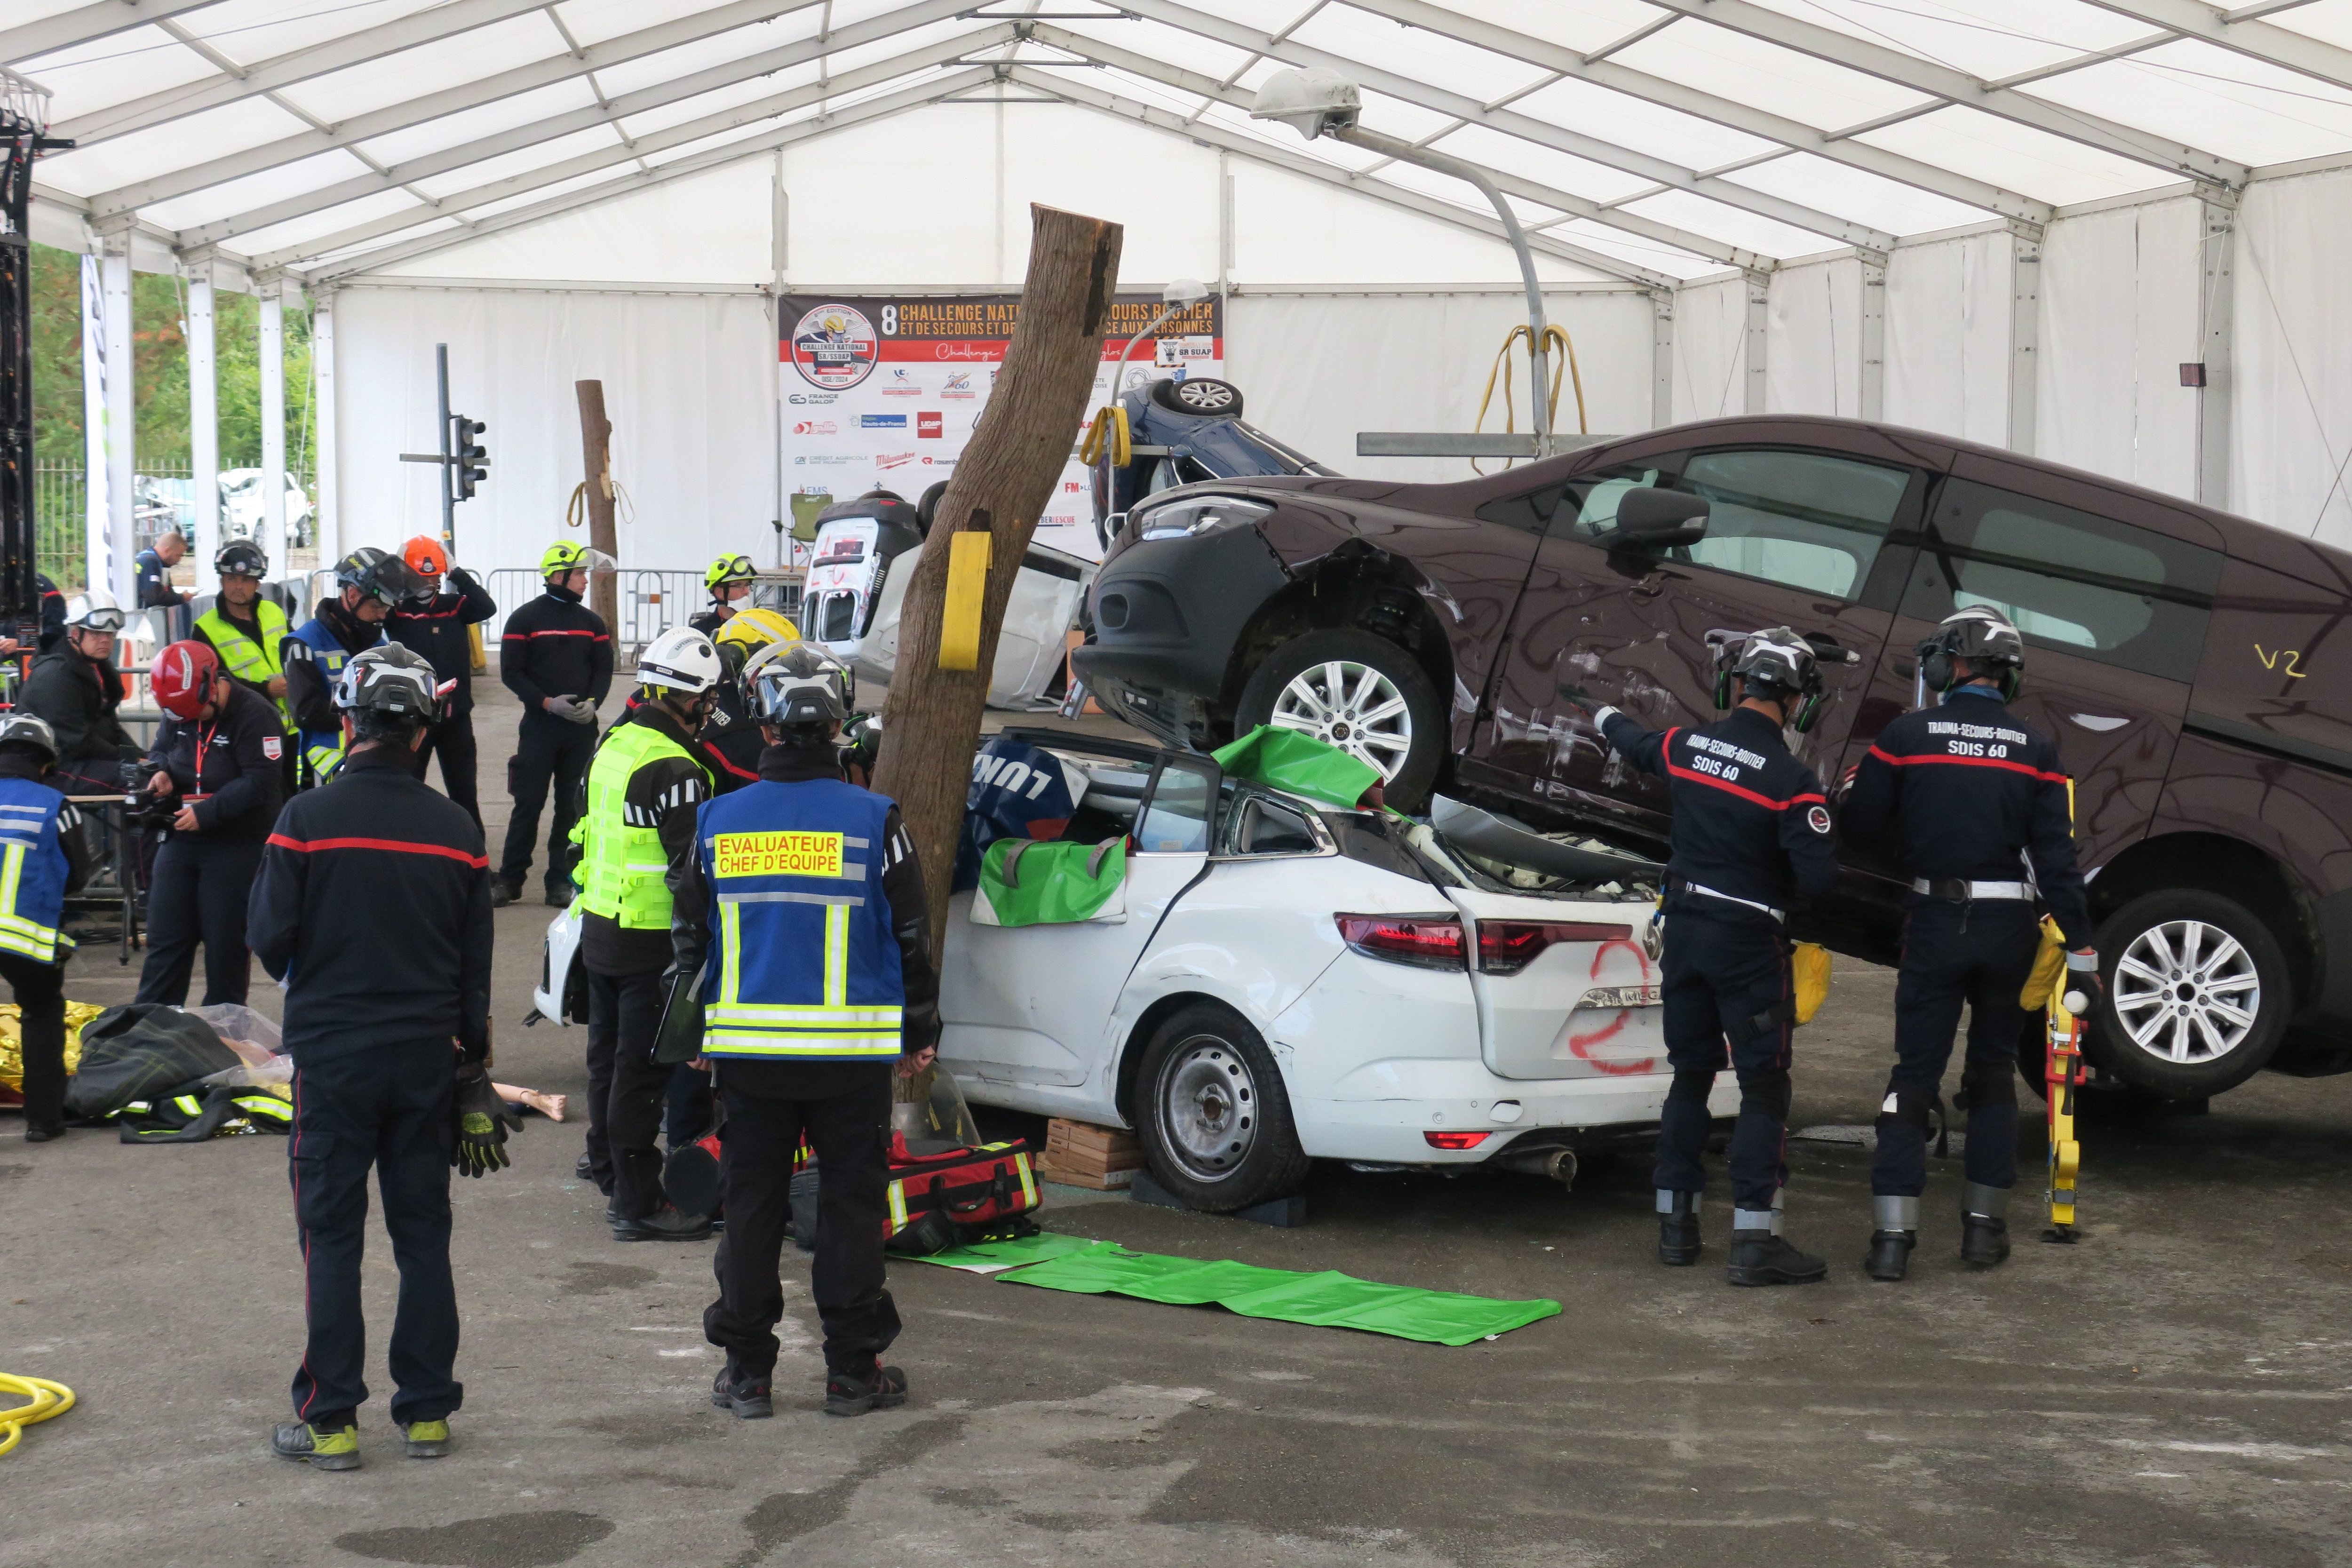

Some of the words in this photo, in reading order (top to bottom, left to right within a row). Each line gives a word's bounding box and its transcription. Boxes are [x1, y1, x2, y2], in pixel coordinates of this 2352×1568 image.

[882, 305, 897, 335] 8
[899, 304, 983, 321] CHALLENGE
[1108, 303, 1148, 320] OURS
[900, 322, 914, 335] ET
[916, 322, 930, 335] DE
[933, 322, 984, 335] SECOURS
[986, 322, 1000, 335] ET
[1121, 321, 1143, 334] AUX
[936, 343, 1000, 361] Challenge
[875, 451, 915, 466] Milwaukee
[2254, 643, 2307, 678] V2
[710, 707, 731, 727] UTIER
[1927, 721, 2027, 745] TRAUMA-SECOURS-ROUTIER
[1686, 734, 1766, 770] TRAUMA-SECOURS-ROUTIER
[1948, 740, 1984, 756] SDIS
[1988, 744, 2007, 758] 60
[1692, 755, 1722, 775] SDIS
[1722, 764, 1740, 781] 60
[719, 836, 838, 855] EVALUATEUR
[720, 856, 759, 873] CHEF
[764, 855, 837, 871] D'EQUIPE
